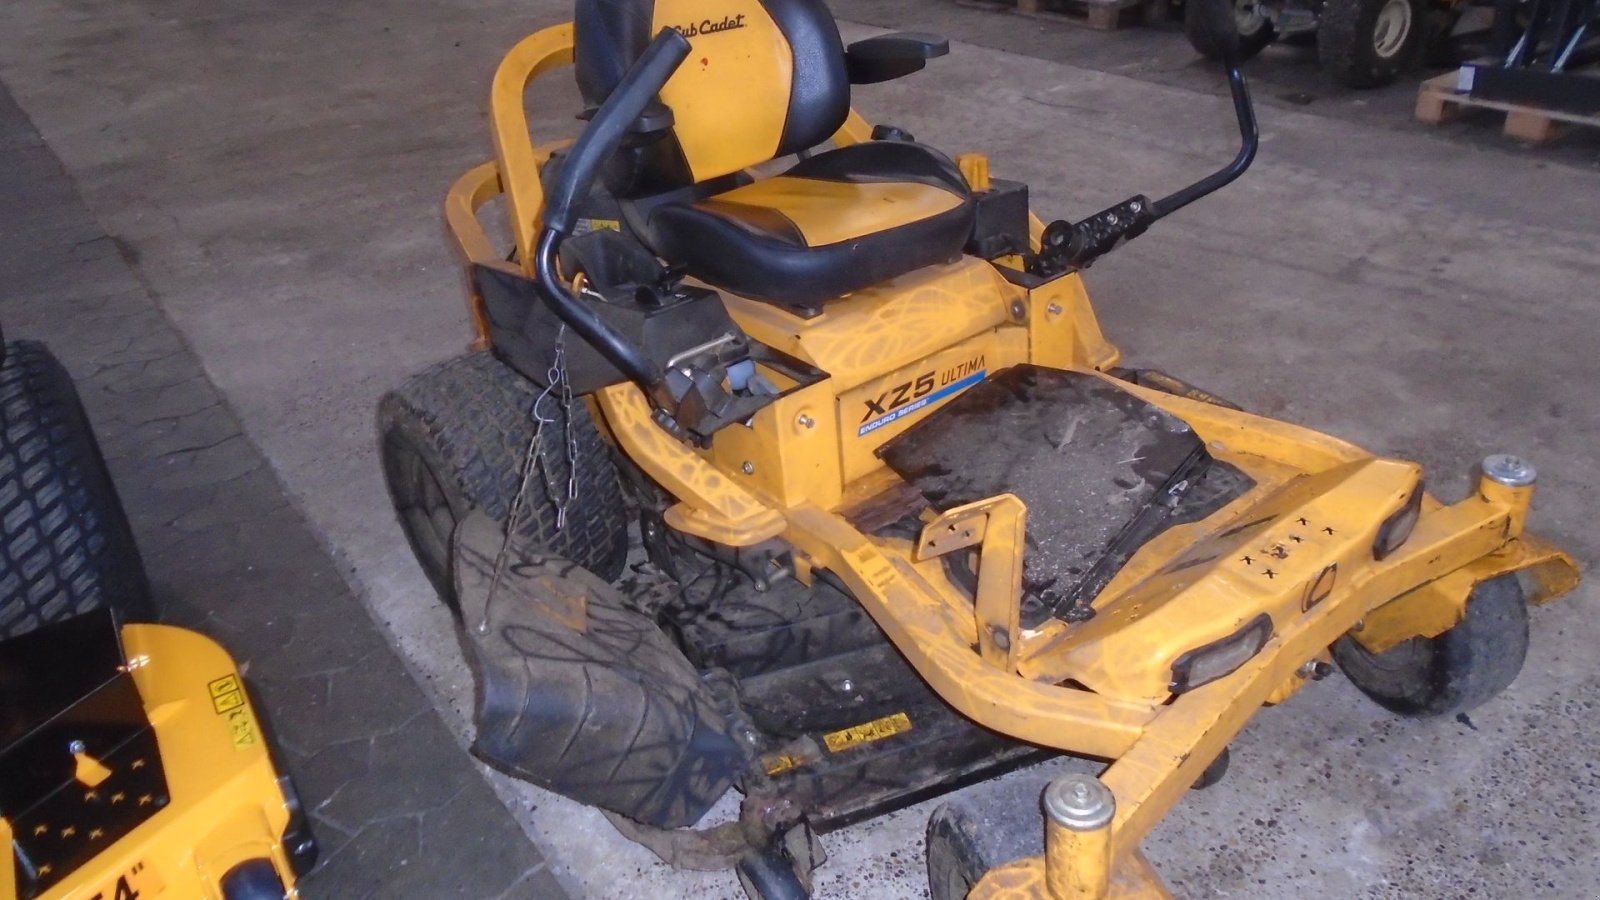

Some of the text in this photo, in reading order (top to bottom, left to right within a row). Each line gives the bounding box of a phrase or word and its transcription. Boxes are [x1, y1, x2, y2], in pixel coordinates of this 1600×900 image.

[699, 14, 745, 35] Cadet
[860, 354, 985, 423] XZ5 ULTIMA
[859, 399, 928, 435] ENDURO SERIES
